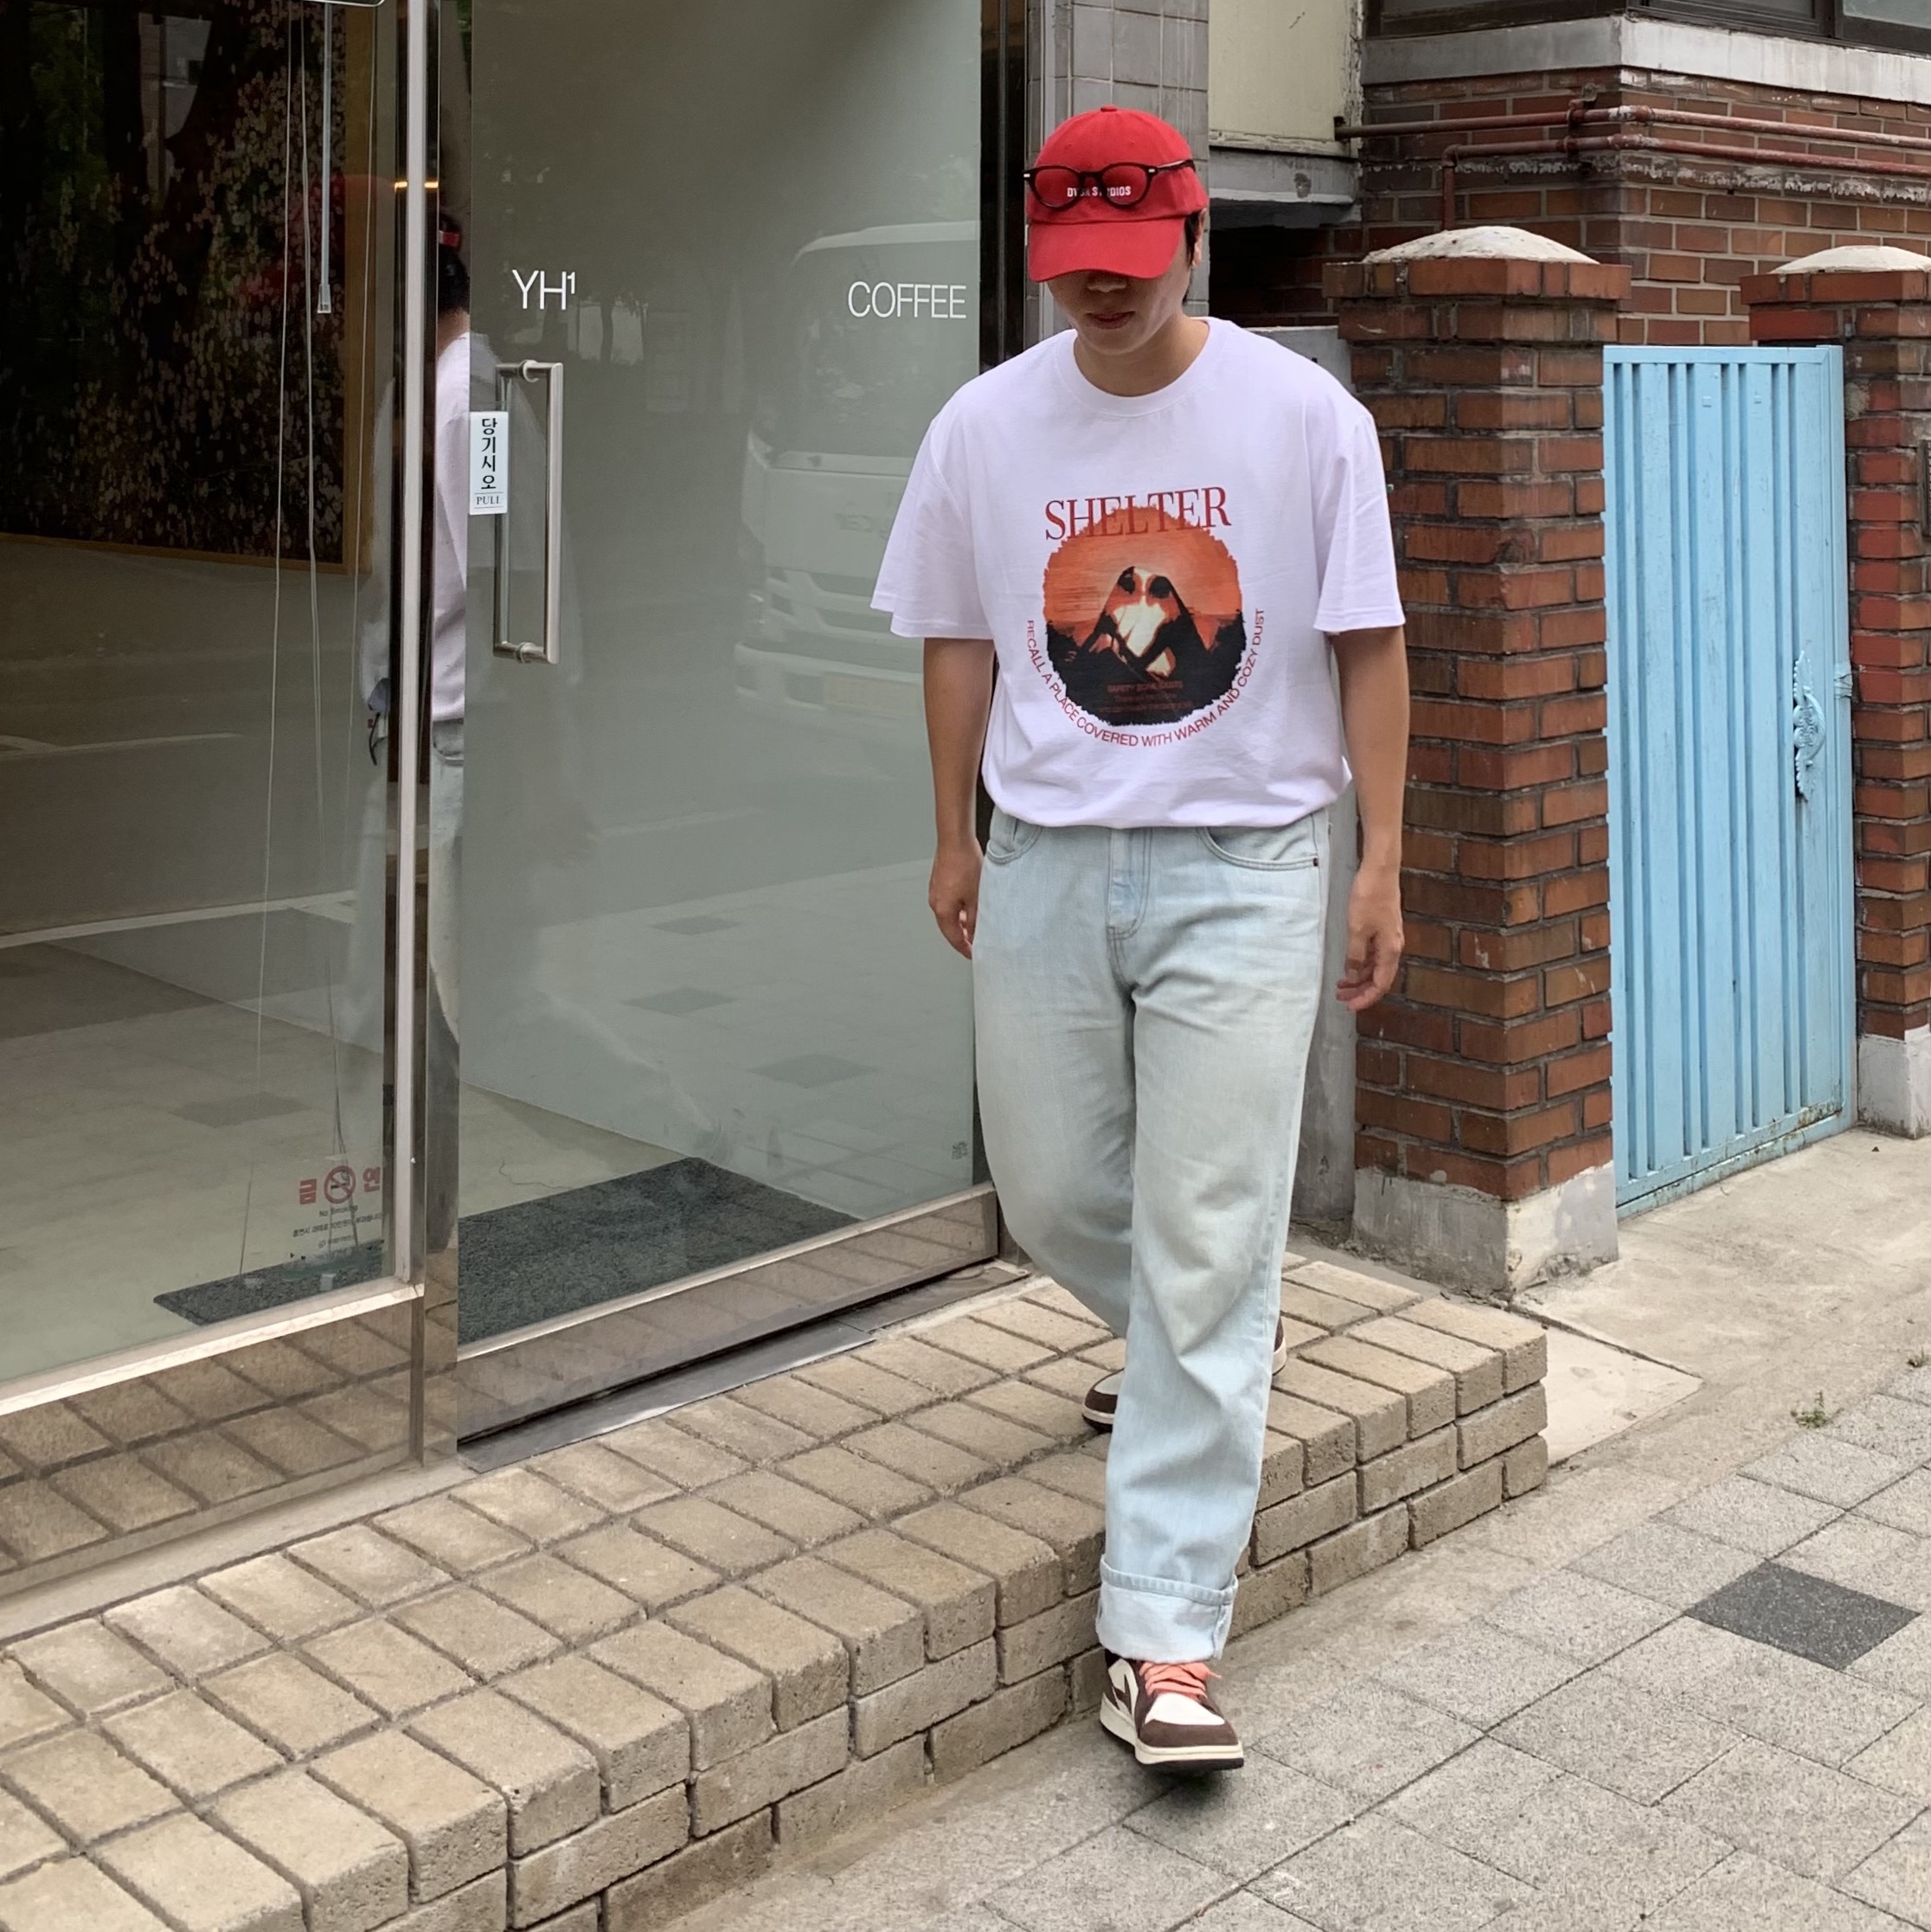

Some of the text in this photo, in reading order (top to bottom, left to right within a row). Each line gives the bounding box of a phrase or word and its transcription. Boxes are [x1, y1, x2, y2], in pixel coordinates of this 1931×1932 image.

[848, 281, 966, 318] COFFEE
[481, 417, 498, 490] 당기시오
[1045, 486, 1232, 541] SHELTER
[1027, 608, 1265, 747] RECALL A PLACE COVERED WITH WARM AND COZY DUST
